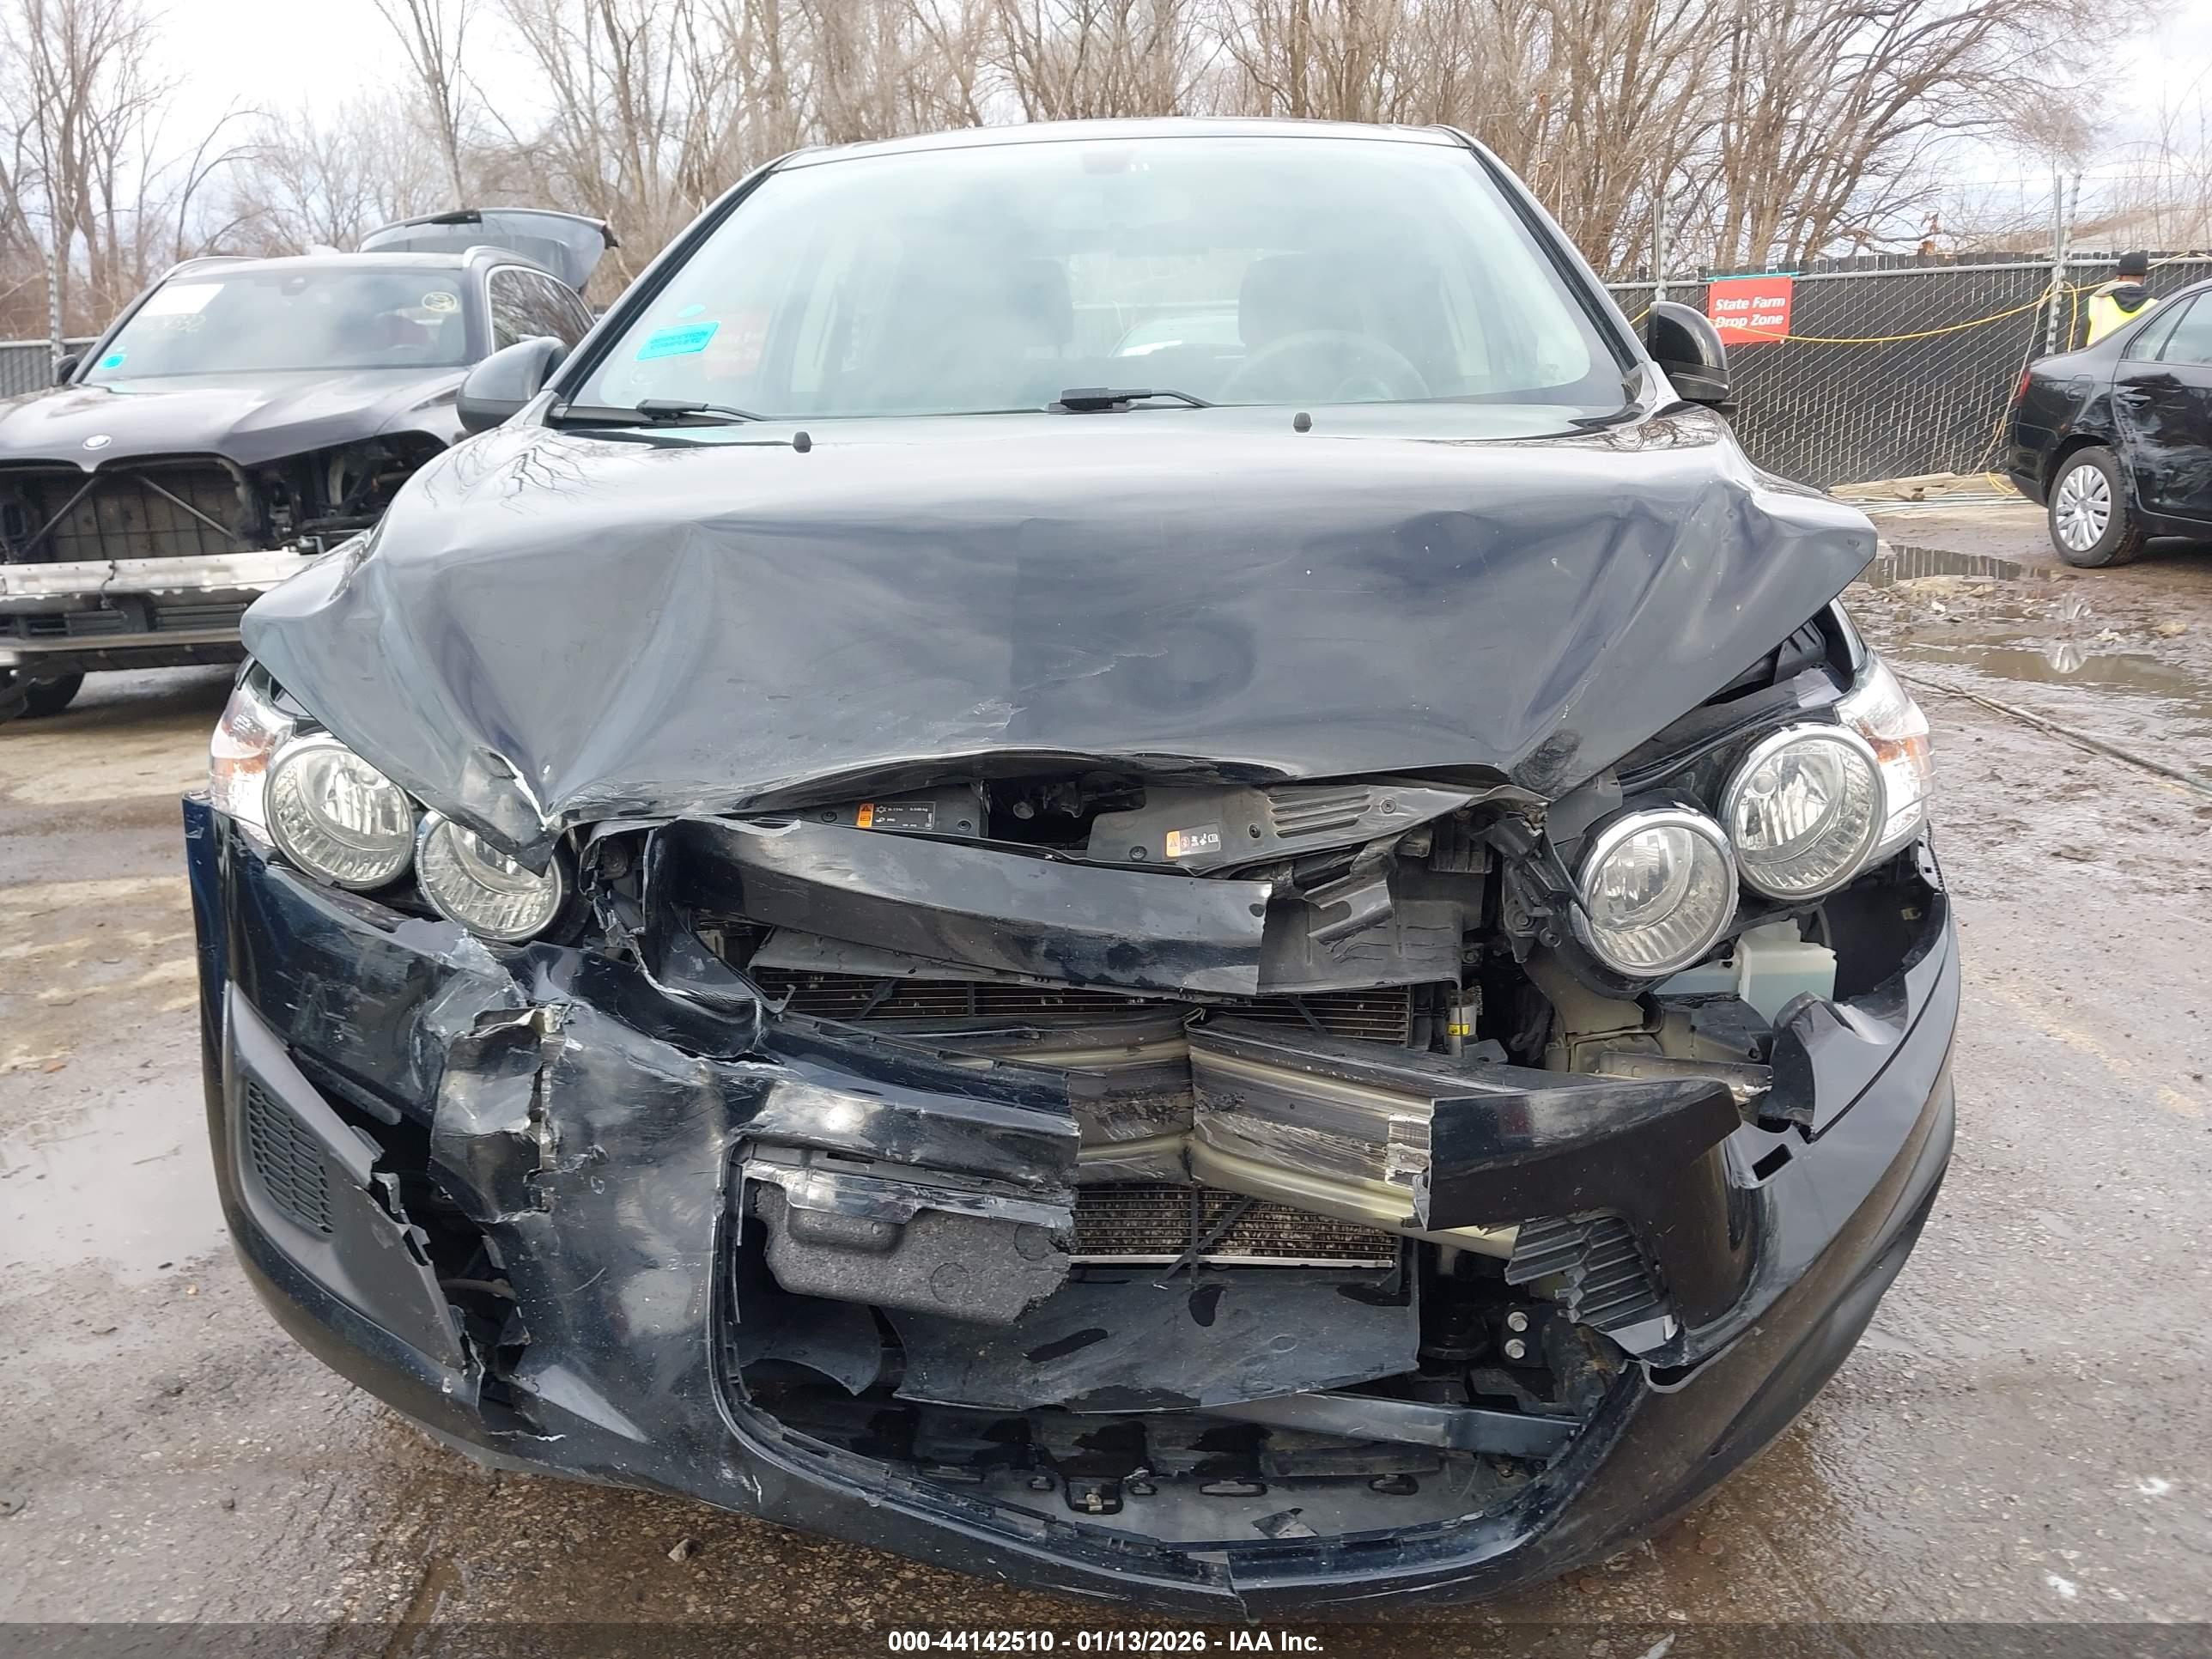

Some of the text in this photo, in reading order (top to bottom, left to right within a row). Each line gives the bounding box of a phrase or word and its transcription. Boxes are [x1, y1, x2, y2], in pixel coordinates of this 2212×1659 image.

[1715, 296, 1786, 311] State Farm
[1715, 314, 1784, 329] Drop Zone
